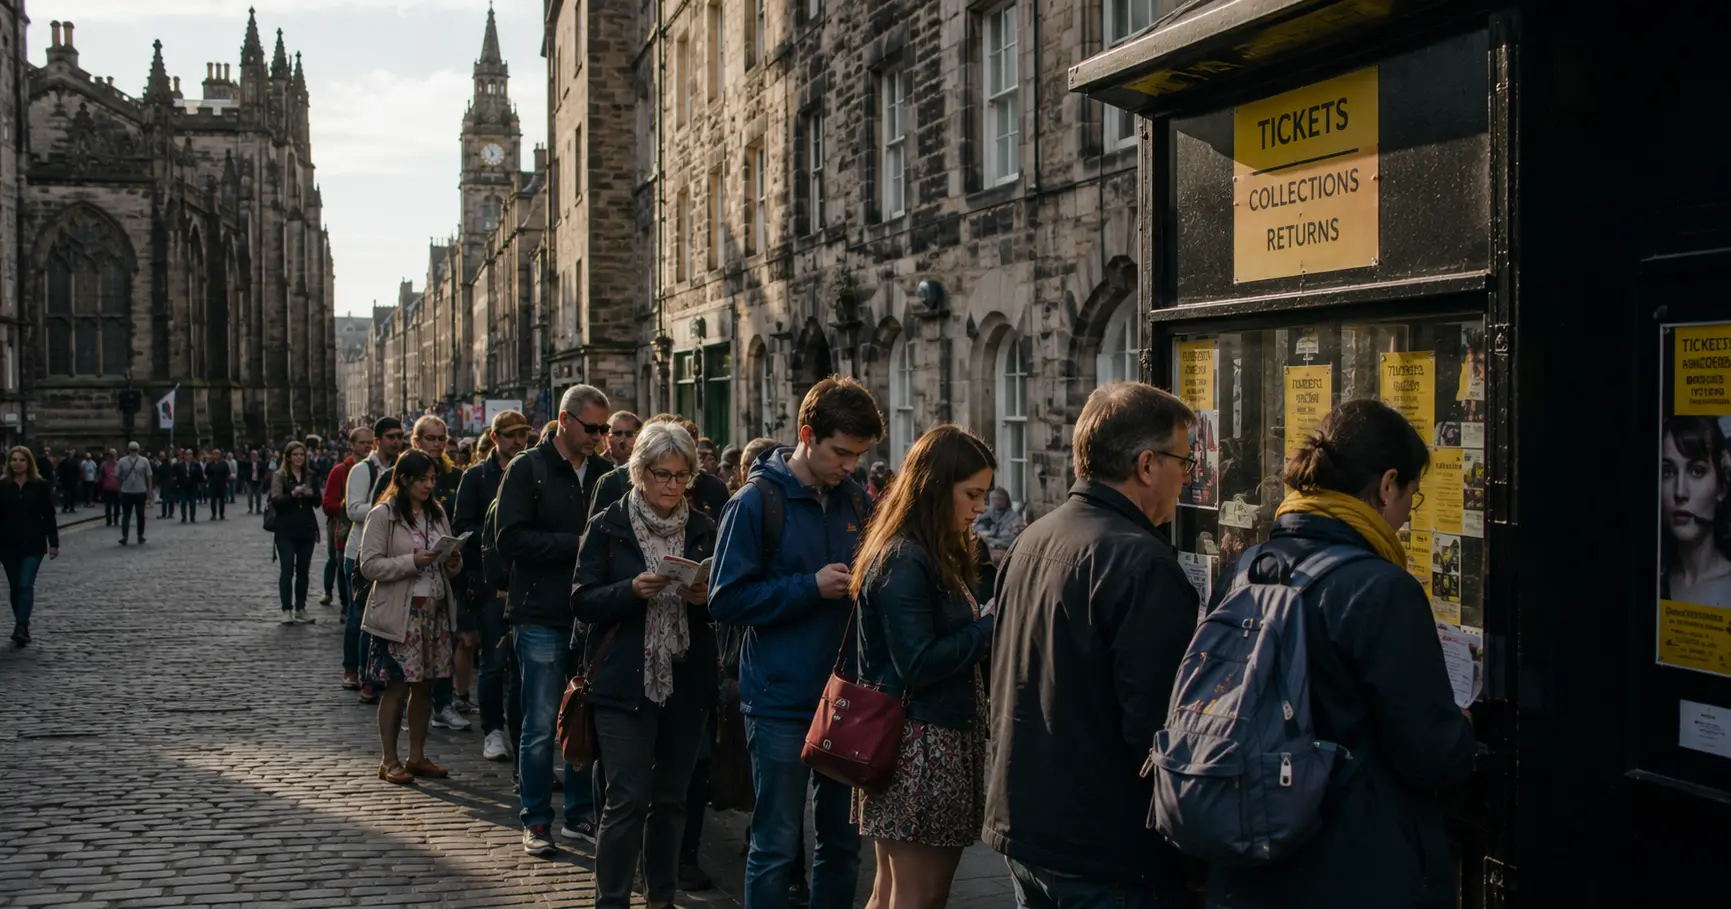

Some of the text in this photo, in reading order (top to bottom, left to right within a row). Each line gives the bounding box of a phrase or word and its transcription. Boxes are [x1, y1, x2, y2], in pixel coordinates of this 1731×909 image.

[1258, 97, 1349, 150] TICKETS
[1249, 168, 1359, 211] COLLECTIONS
[1267, 217, 1339, 252] RETURNS
